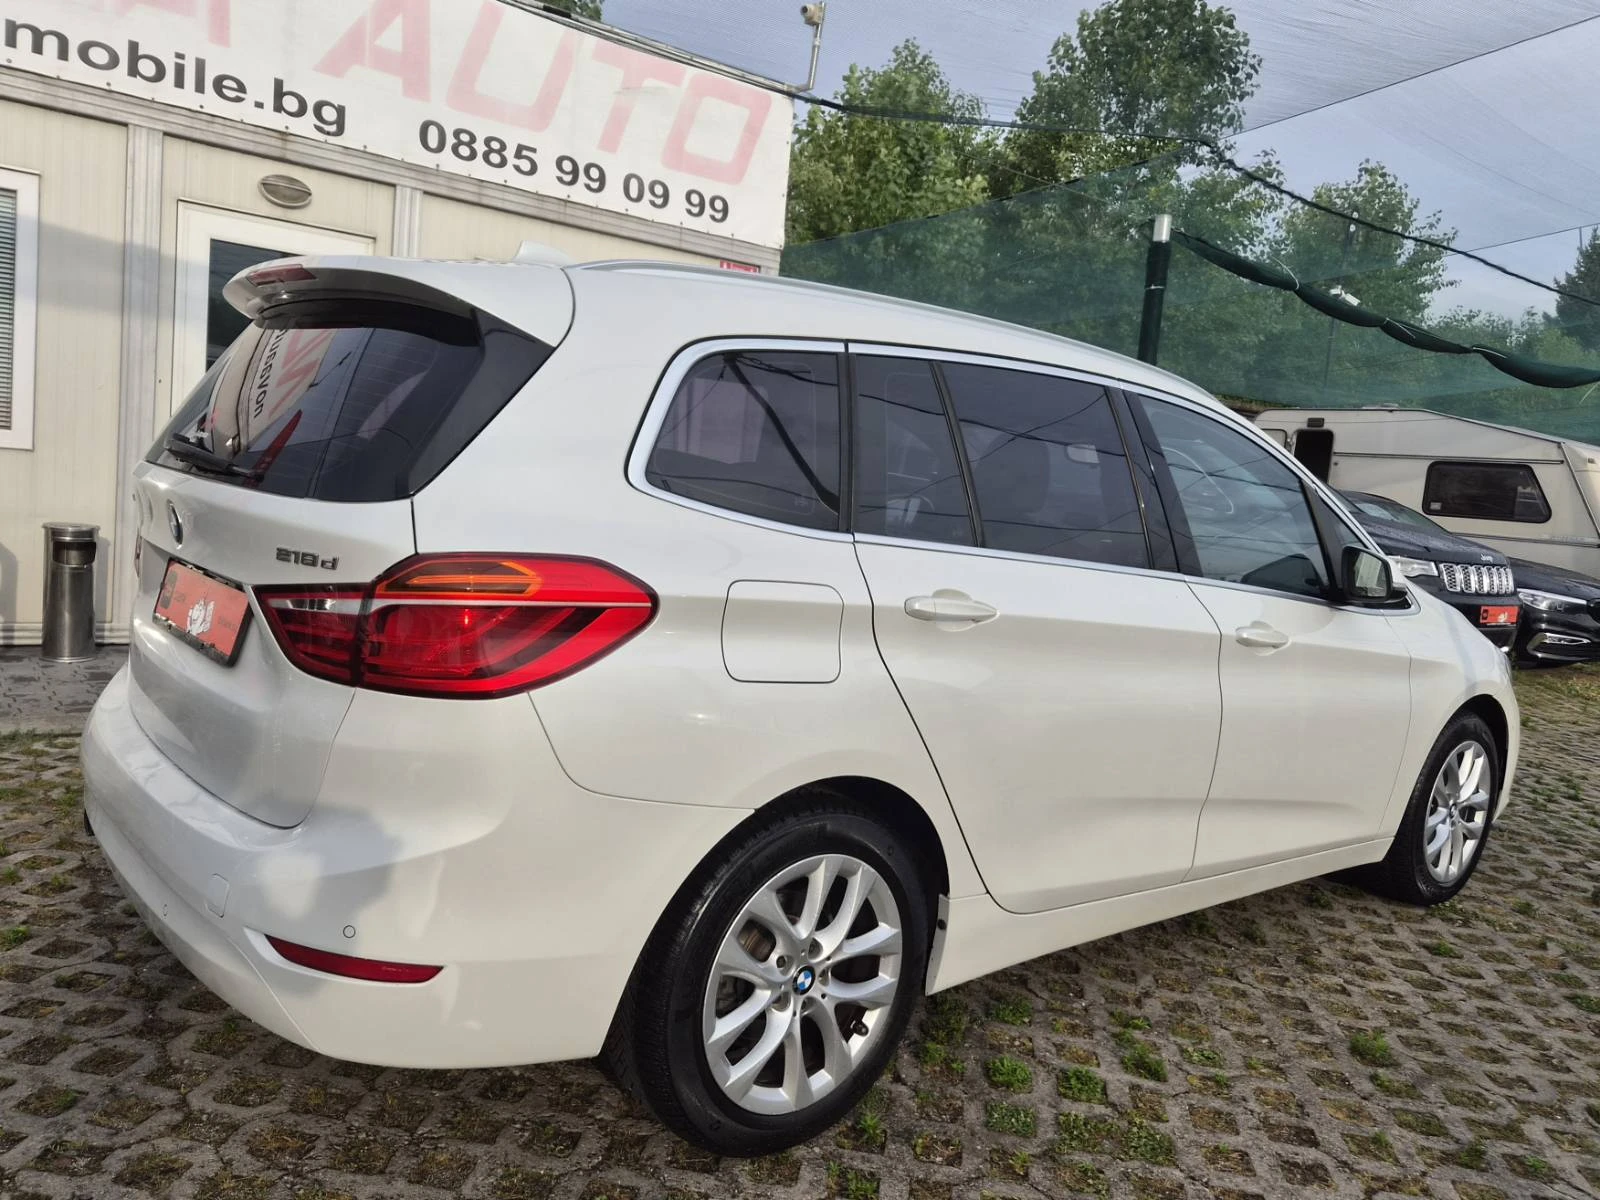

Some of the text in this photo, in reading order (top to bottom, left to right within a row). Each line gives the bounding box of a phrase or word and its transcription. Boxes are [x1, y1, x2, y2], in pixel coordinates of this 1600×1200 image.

[5, 19, 346, 136] mobile.bg
[313, 0, 772, 186] AUTO
[419, 119, 730, 223] 0885 99 09 99
